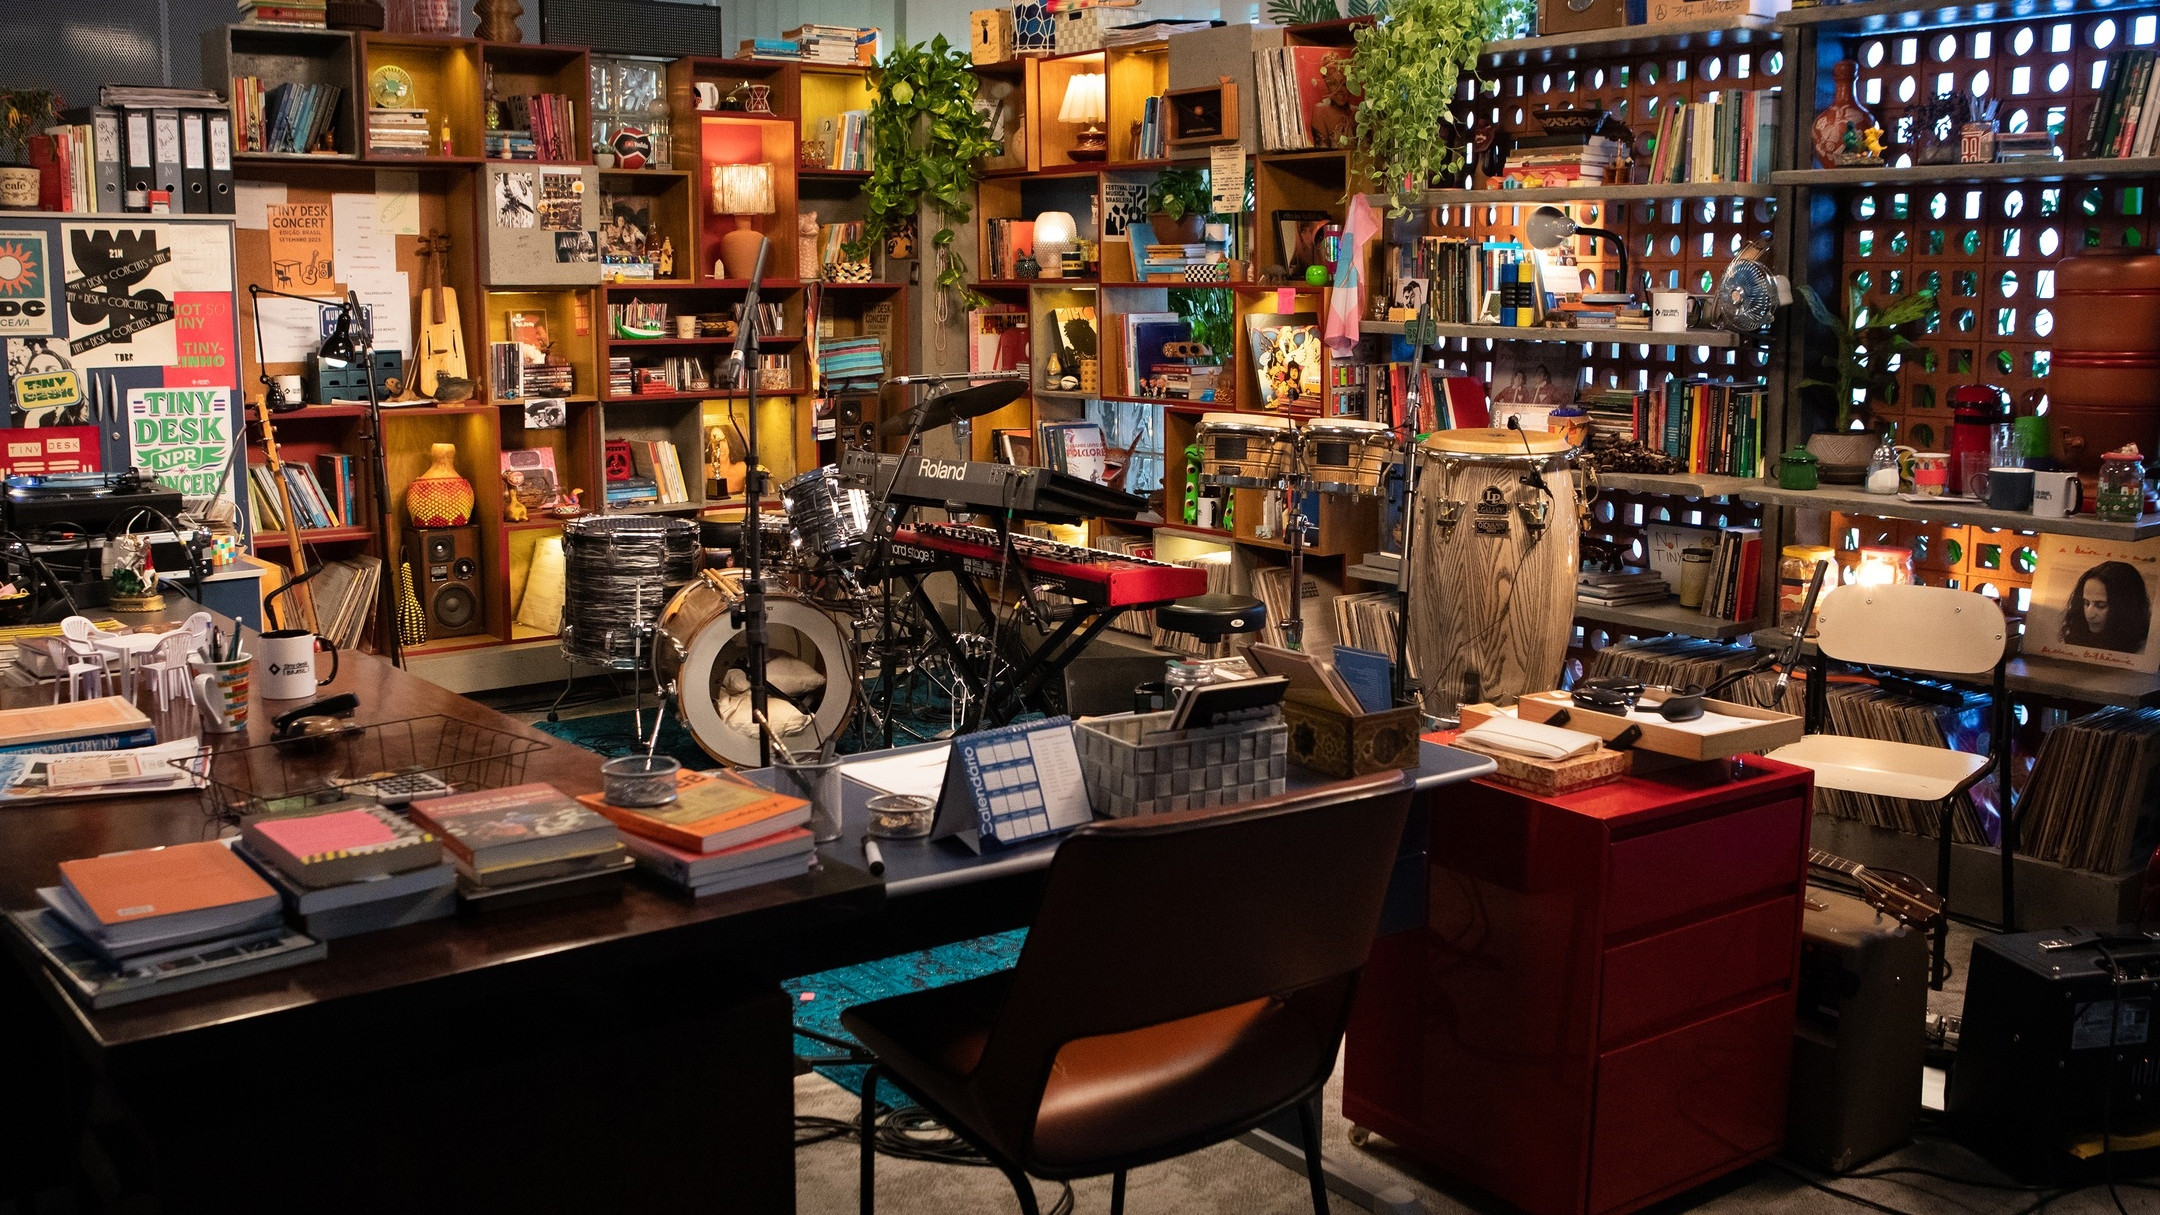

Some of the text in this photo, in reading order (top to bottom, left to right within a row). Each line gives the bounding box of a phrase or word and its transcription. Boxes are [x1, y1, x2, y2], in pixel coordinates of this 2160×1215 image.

[271, 205, 328, 216] TINY DESK
[272, 218, 325, 228] CONCERT
[206, 304, 226, 316] SO
[865, 314, 890, 324] CONCERT
[24, 376, 67, 390] TINY
[22, 387, 75, 403] DESK
[143, 391, 218, 416] TINY
[134, 416, 227, 447] DESK
[10, 446, 40, 454] TINY
[48, 441, 78, 450] DESK
[158, 448, 197, 468] NPR
[1066, 448, 1106, 458] FOLCLORE
[918, 458, 968, 481] Roland
[1486, 490, 1500, 504] LP
[907, 547, 930, 563] stage
[930, 550, 935, 562] 3
